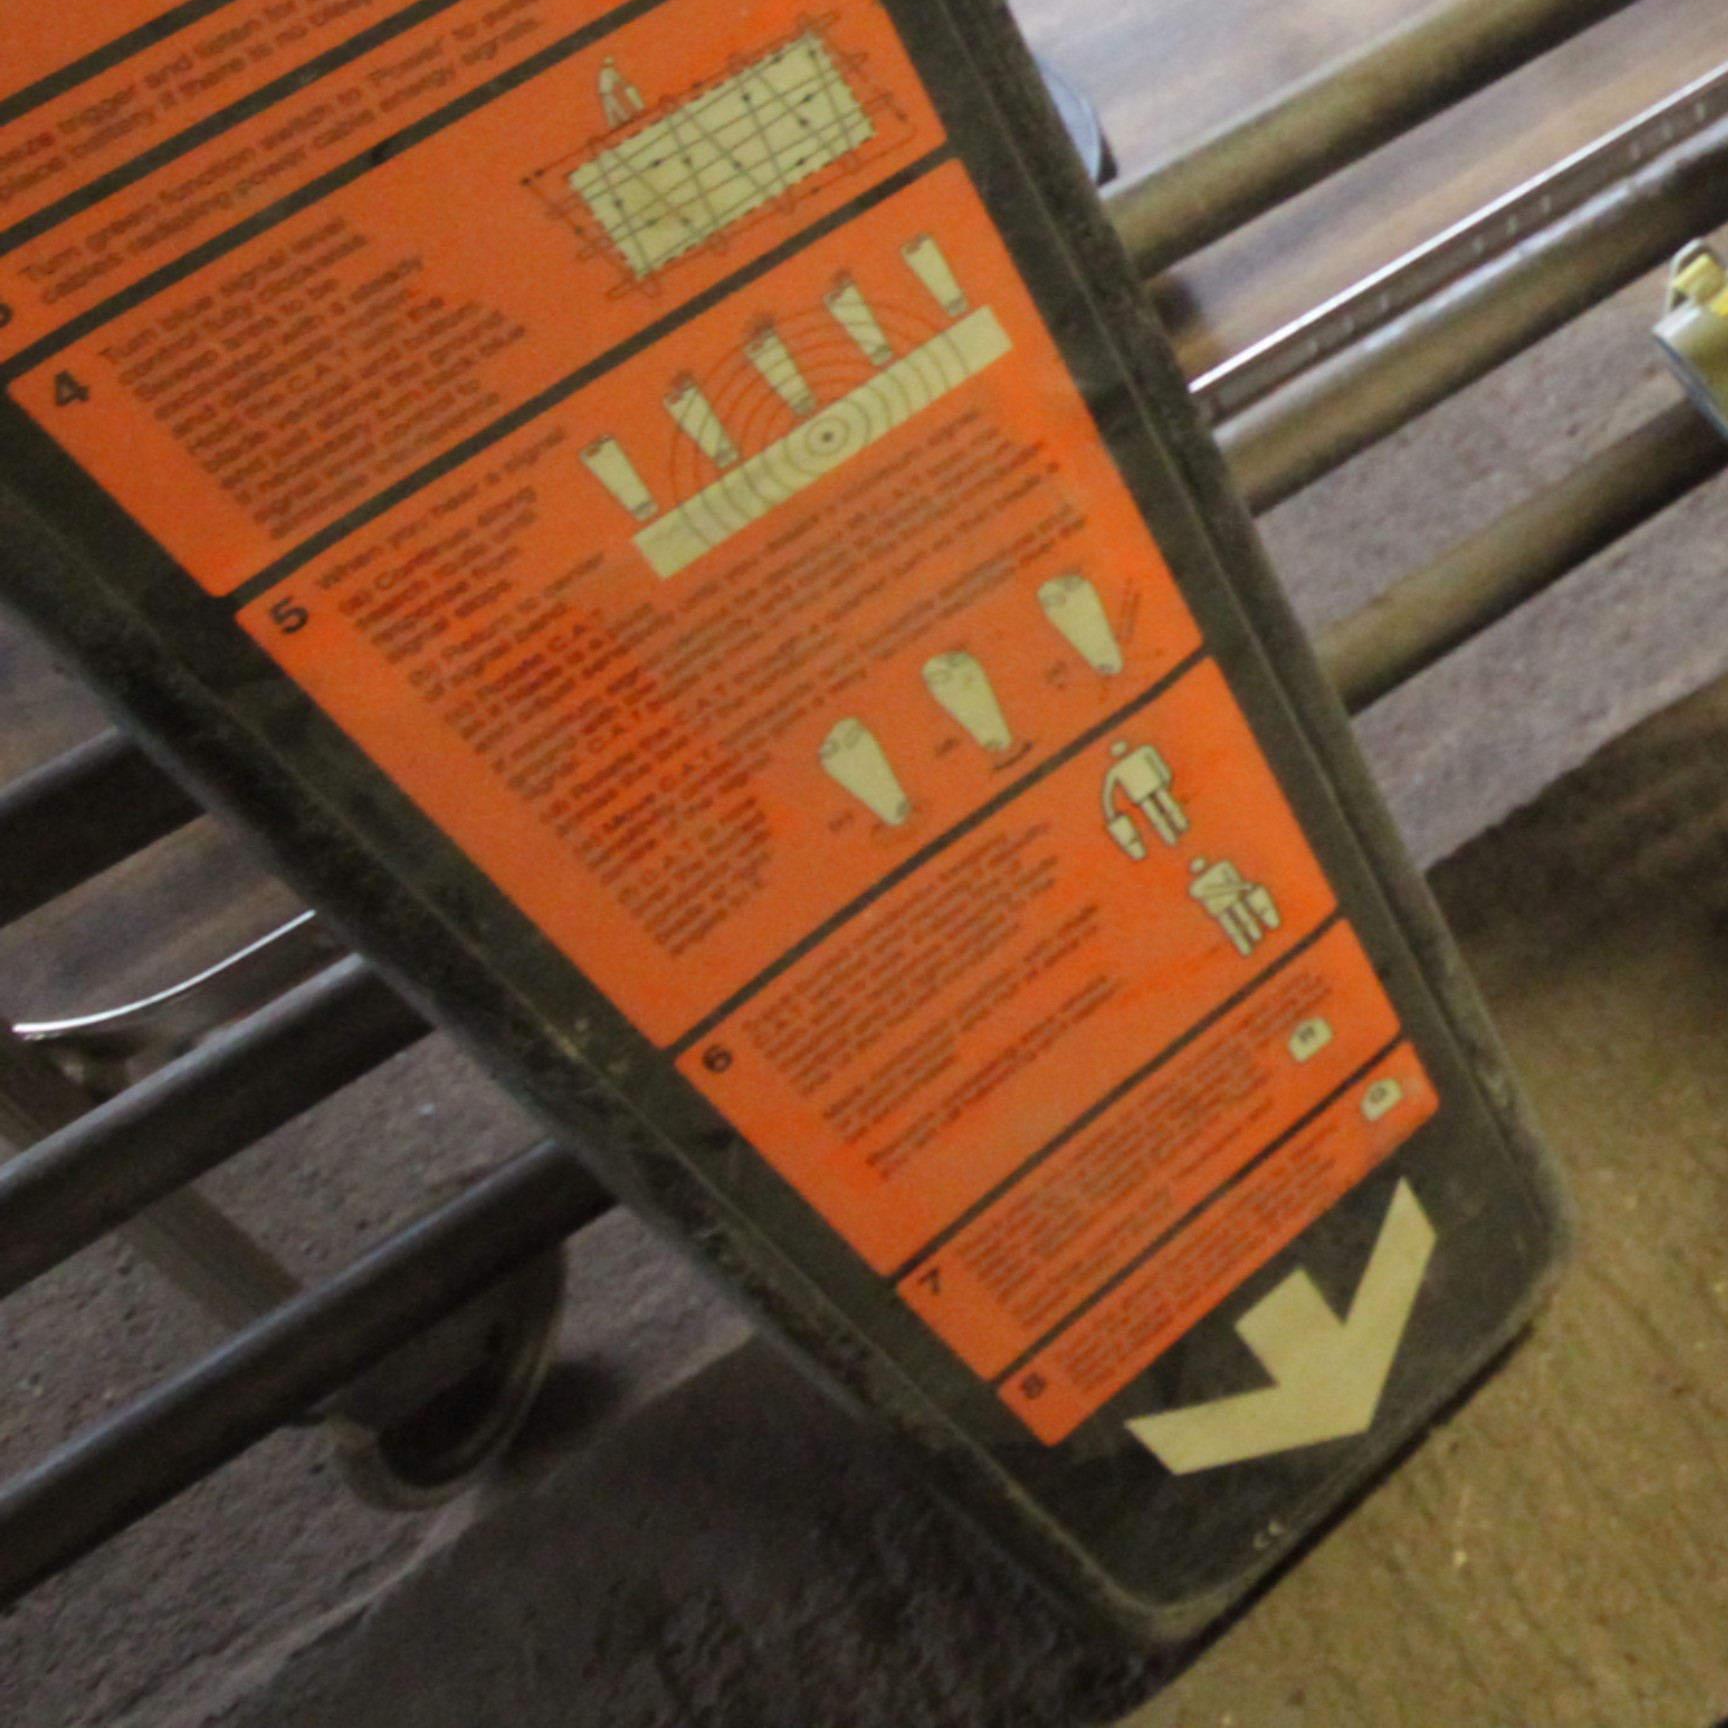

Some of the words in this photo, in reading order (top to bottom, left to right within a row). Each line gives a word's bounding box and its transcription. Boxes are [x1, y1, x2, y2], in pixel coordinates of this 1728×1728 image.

[53, 372, 91, 409] 4
[269, 595, 311, 635] 5
[699, 1041, 733, 1076] 6
[916, 1269, 943, 1298] 7
